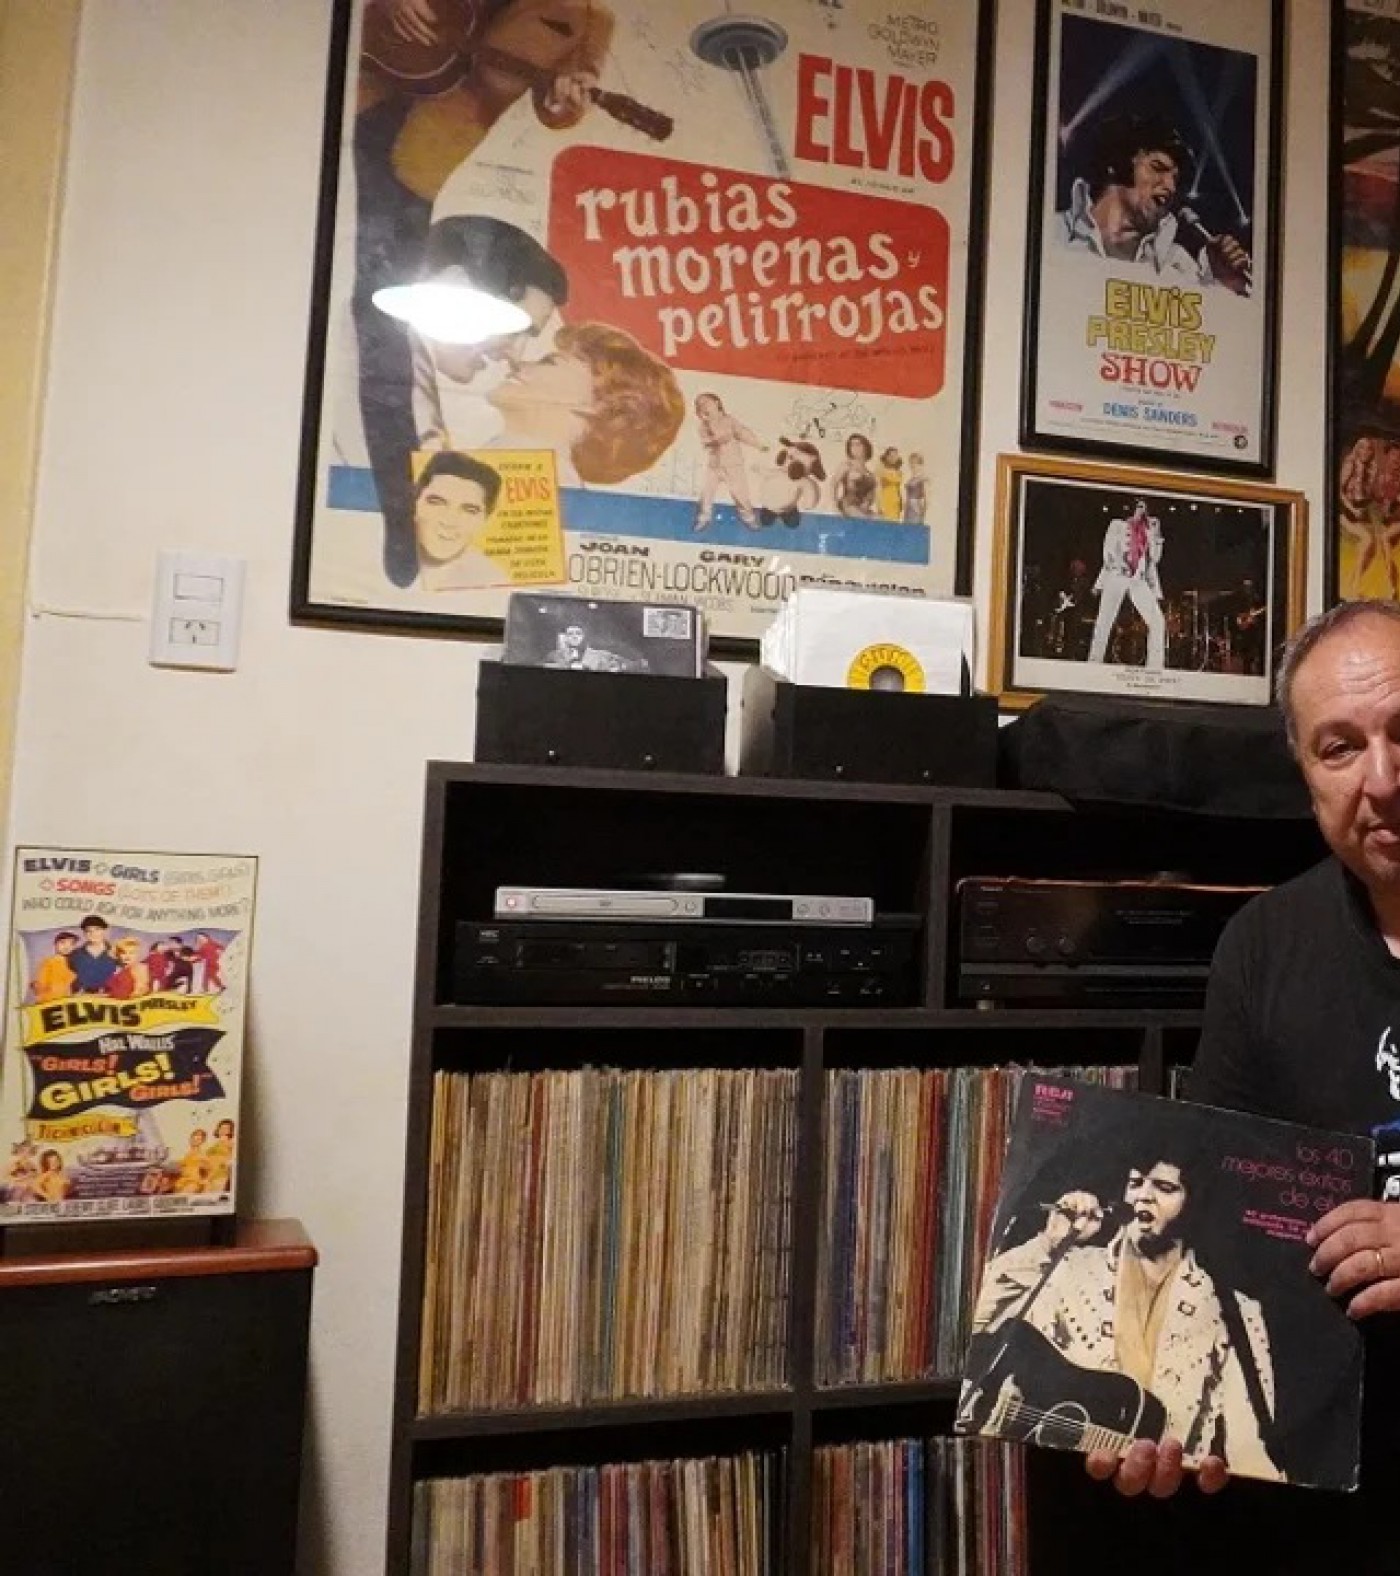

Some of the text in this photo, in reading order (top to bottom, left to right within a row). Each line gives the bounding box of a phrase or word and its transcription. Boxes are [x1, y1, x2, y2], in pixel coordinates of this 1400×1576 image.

[795, 52, 955, 184] ELVIS
[575, 175, 798, 241] rubias
[613, 233, 900, 298] morenas
[658, 285, 944, 358] pelirrojas
[1086, 315, 1216, 363] PRESLEY
[1100, 352, 1203, 392] SHOW
[1102, 401, 1139, 420] DENIS
[1143, 404, 1199, 428] SANDERS
[505, 476, 549, 502] ELVIS
[580, 543, 649, 557] JOAN
[700, 550, 764, 568] GARY
[24, 857, 92, 872] ELVIS
[110, 863, 160, 883] GIRLS
[56, 877, 117, 896] SONGS
[54, 896, 93, 912] COULD
[146, 906, 206, 921] ANYTHING
[41, 998, 198, 1034] ELVIS PRESLEY
[98, 1035, 129, 1054] HAL
[39, 1052, 175, 1111] GIRLS!
[1221, 1156, 1297, 1183] mejores
[1323, 1147, 1354, 1170] 40
[1280, 1187, 1311, 1209] de
